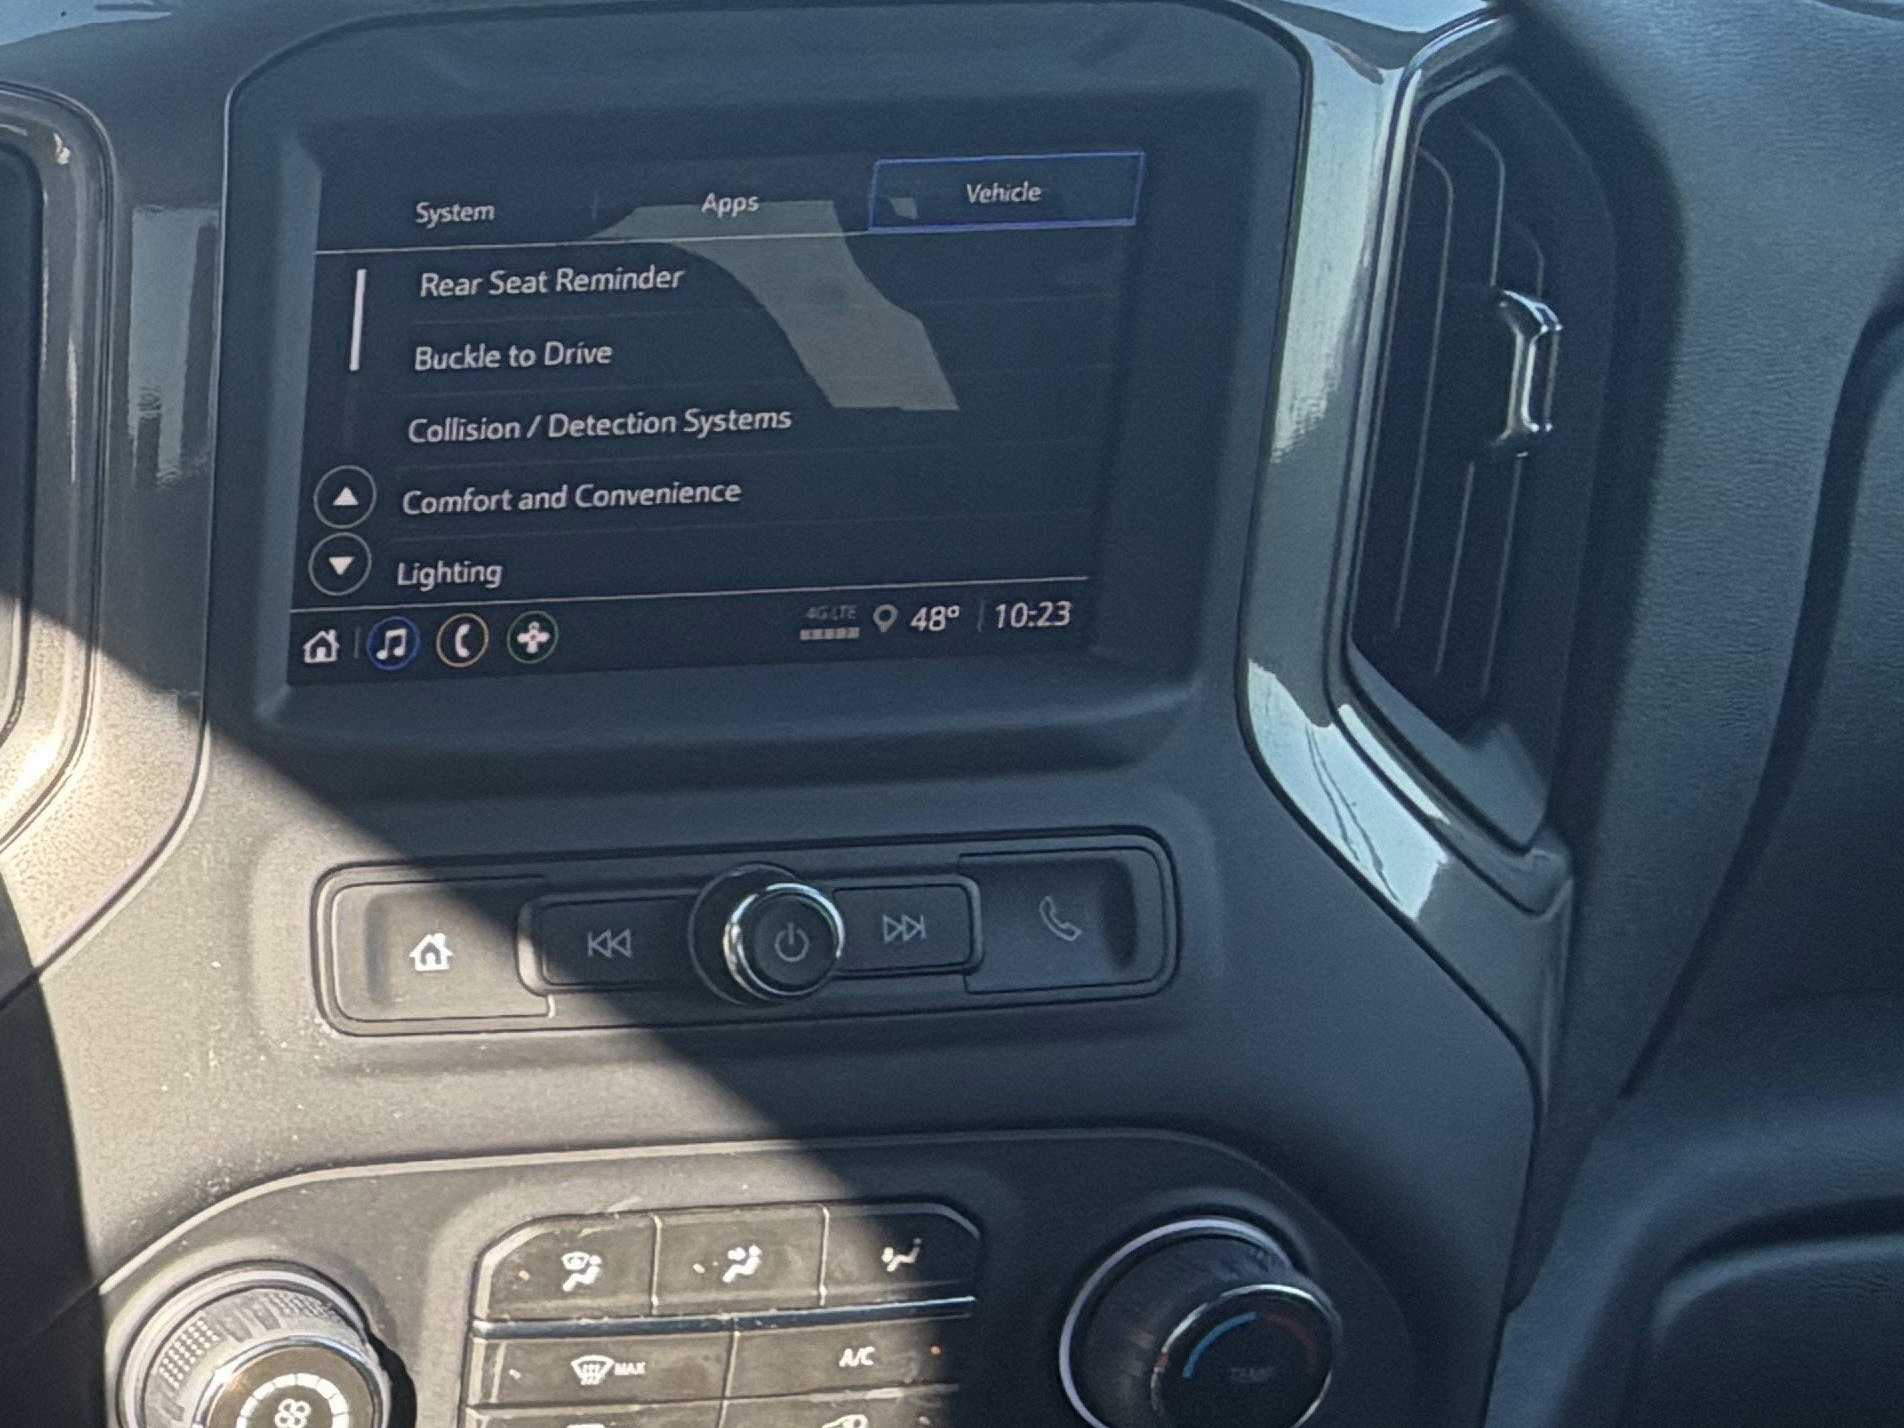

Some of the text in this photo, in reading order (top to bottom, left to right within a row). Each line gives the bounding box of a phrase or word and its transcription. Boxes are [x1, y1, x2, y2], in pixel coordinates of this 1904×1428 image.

[415, 180, 1042, 226] System Apps Vehicle
[419, 263, 686, 298] Rear Seat Reminder
[414, 340, 613, 372] Buckle to Drive
[408, 417, 520, 444] Collision
[548, 410, 677, 440] Detection
[683, 407, 793, 438] Systems
[402, 479, 742, 517] Comfort and Convenience
[396, 559, 503, 591] Lighting
[995, 600, 1073, 629] 10:23
[614, 1361, 646, 1376] MAX
[839, 1346, 875, 1369] A/C
